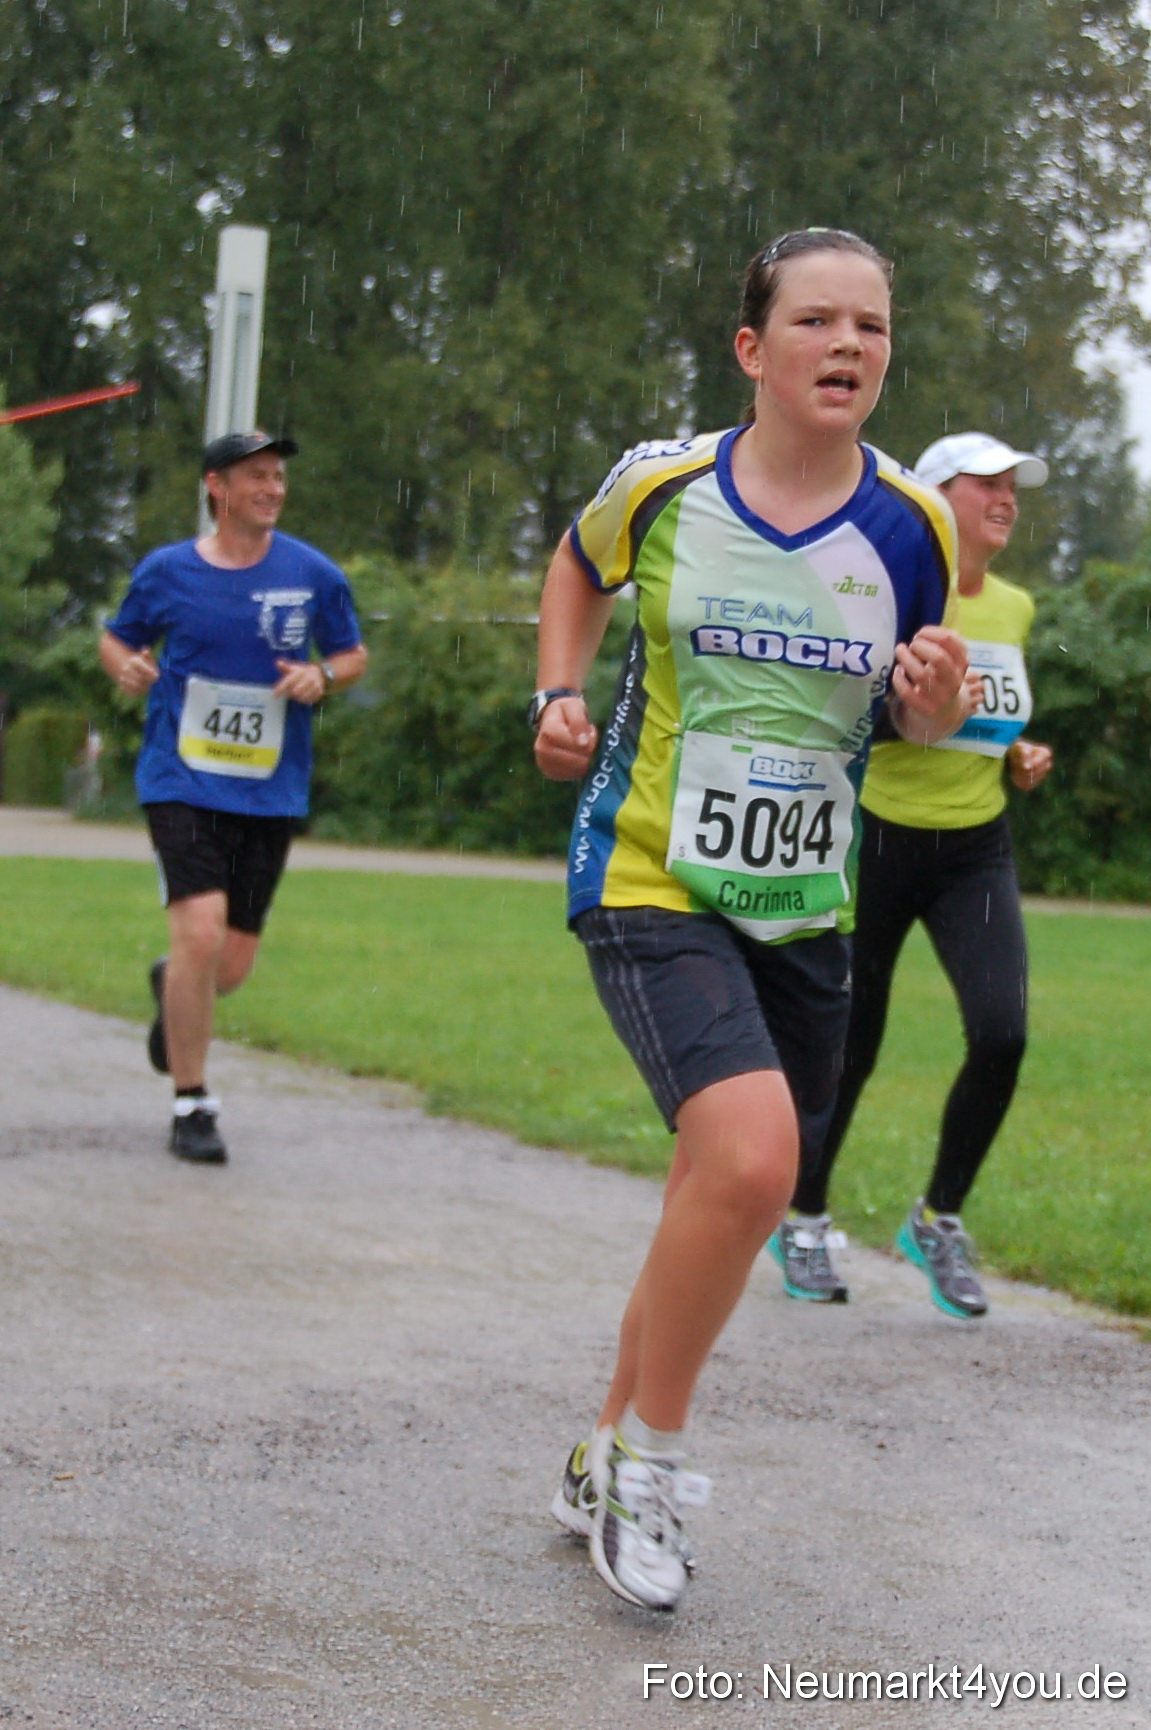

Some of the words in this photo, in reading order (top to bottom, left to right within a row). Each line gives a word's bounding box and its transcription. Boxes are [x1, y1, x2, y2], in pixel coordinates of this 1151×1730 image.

[697, 596, 813, 630] TEAM
[690, 624, 873, 677] BOCK
[979, 673, 1020, 715] 05
[204, 707, 264, 745] 443
[695, 787, 836, 869] 5094
[718, 880, 806, 914] Corinna
